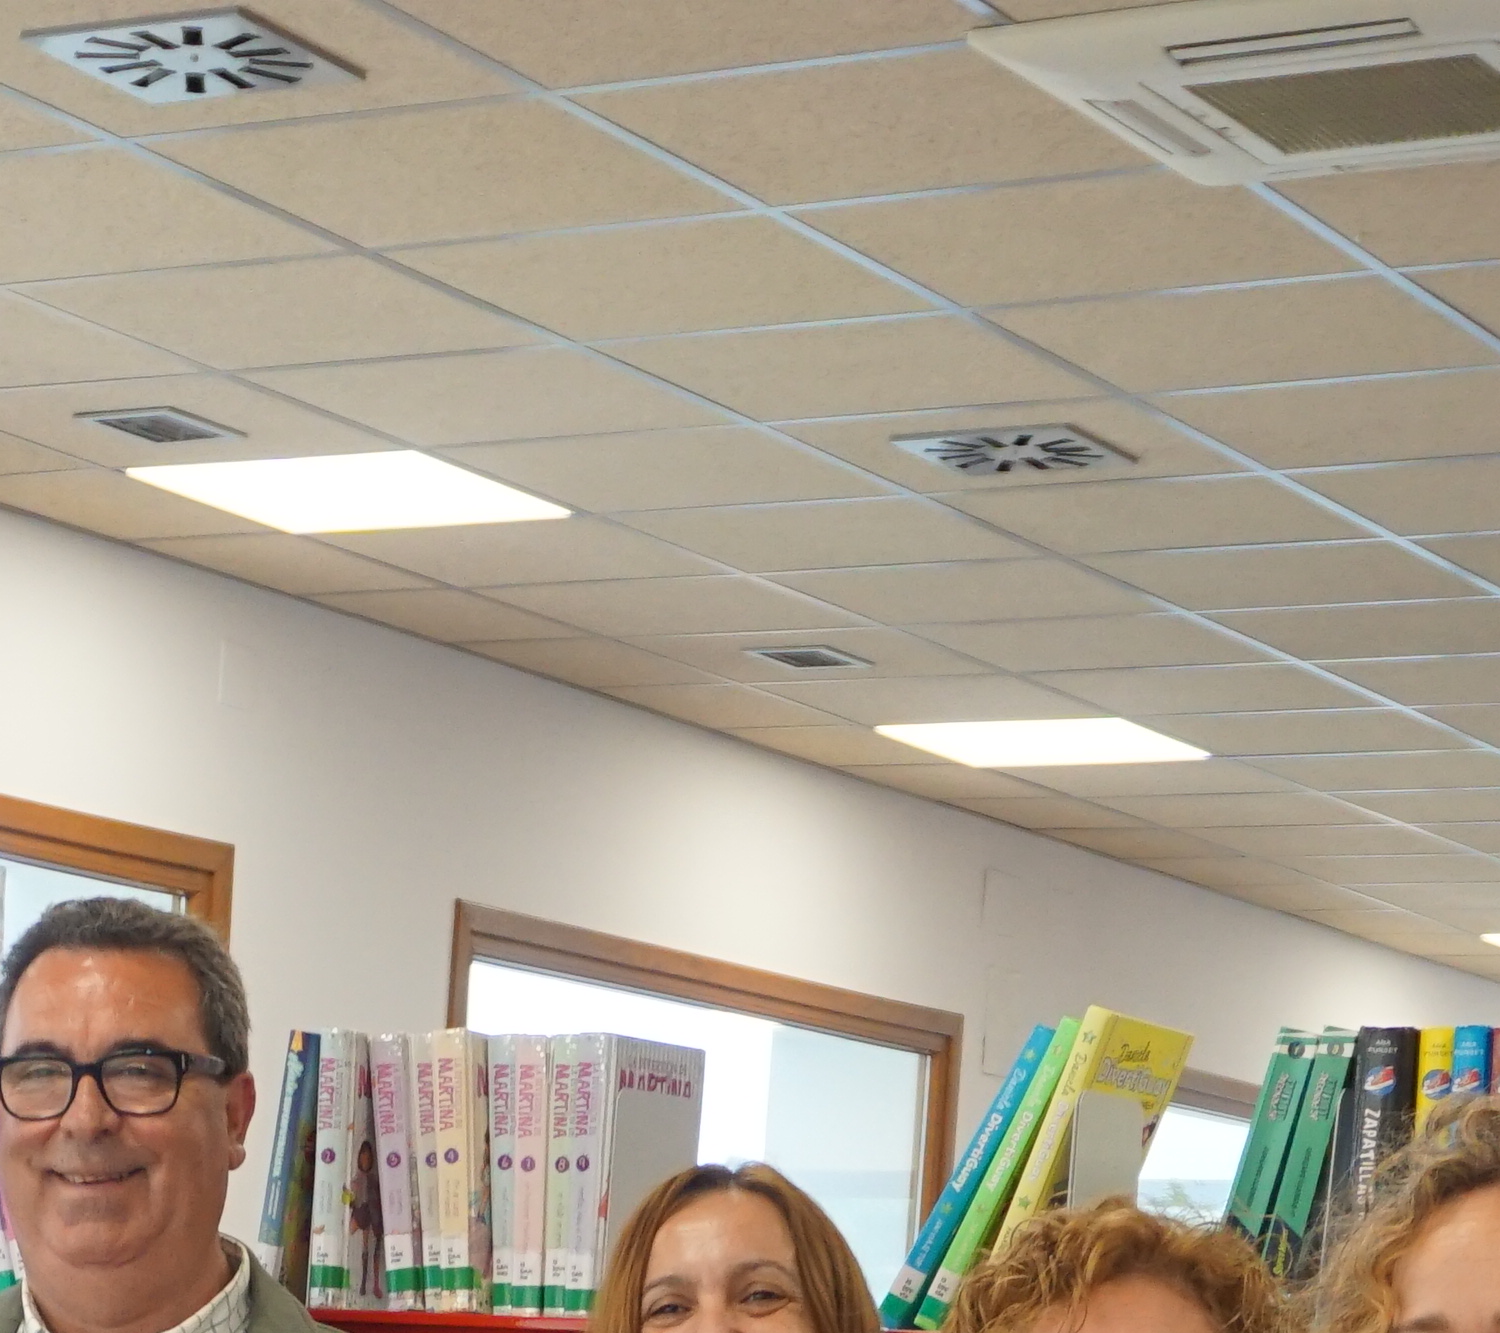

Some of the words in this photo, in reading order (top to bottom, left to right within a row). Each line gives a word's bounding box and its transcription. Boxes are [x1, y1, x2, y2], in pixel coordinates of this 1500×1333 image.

[318, 1057, 336, 1131] MARTINA
[376, 1063, 395, 1136] MARTINA
[417, 1063, 436, 1136] MARTINA
[438, 1057, 454, 1132] MARTINA
[494, 1063, 510, 1138] MARTINA
[518, 1064, 535, 1138] MARTINA
[553, 1064, 570, 1139] MARTINA
[575, 1062, 593, 1137] MARTINA
